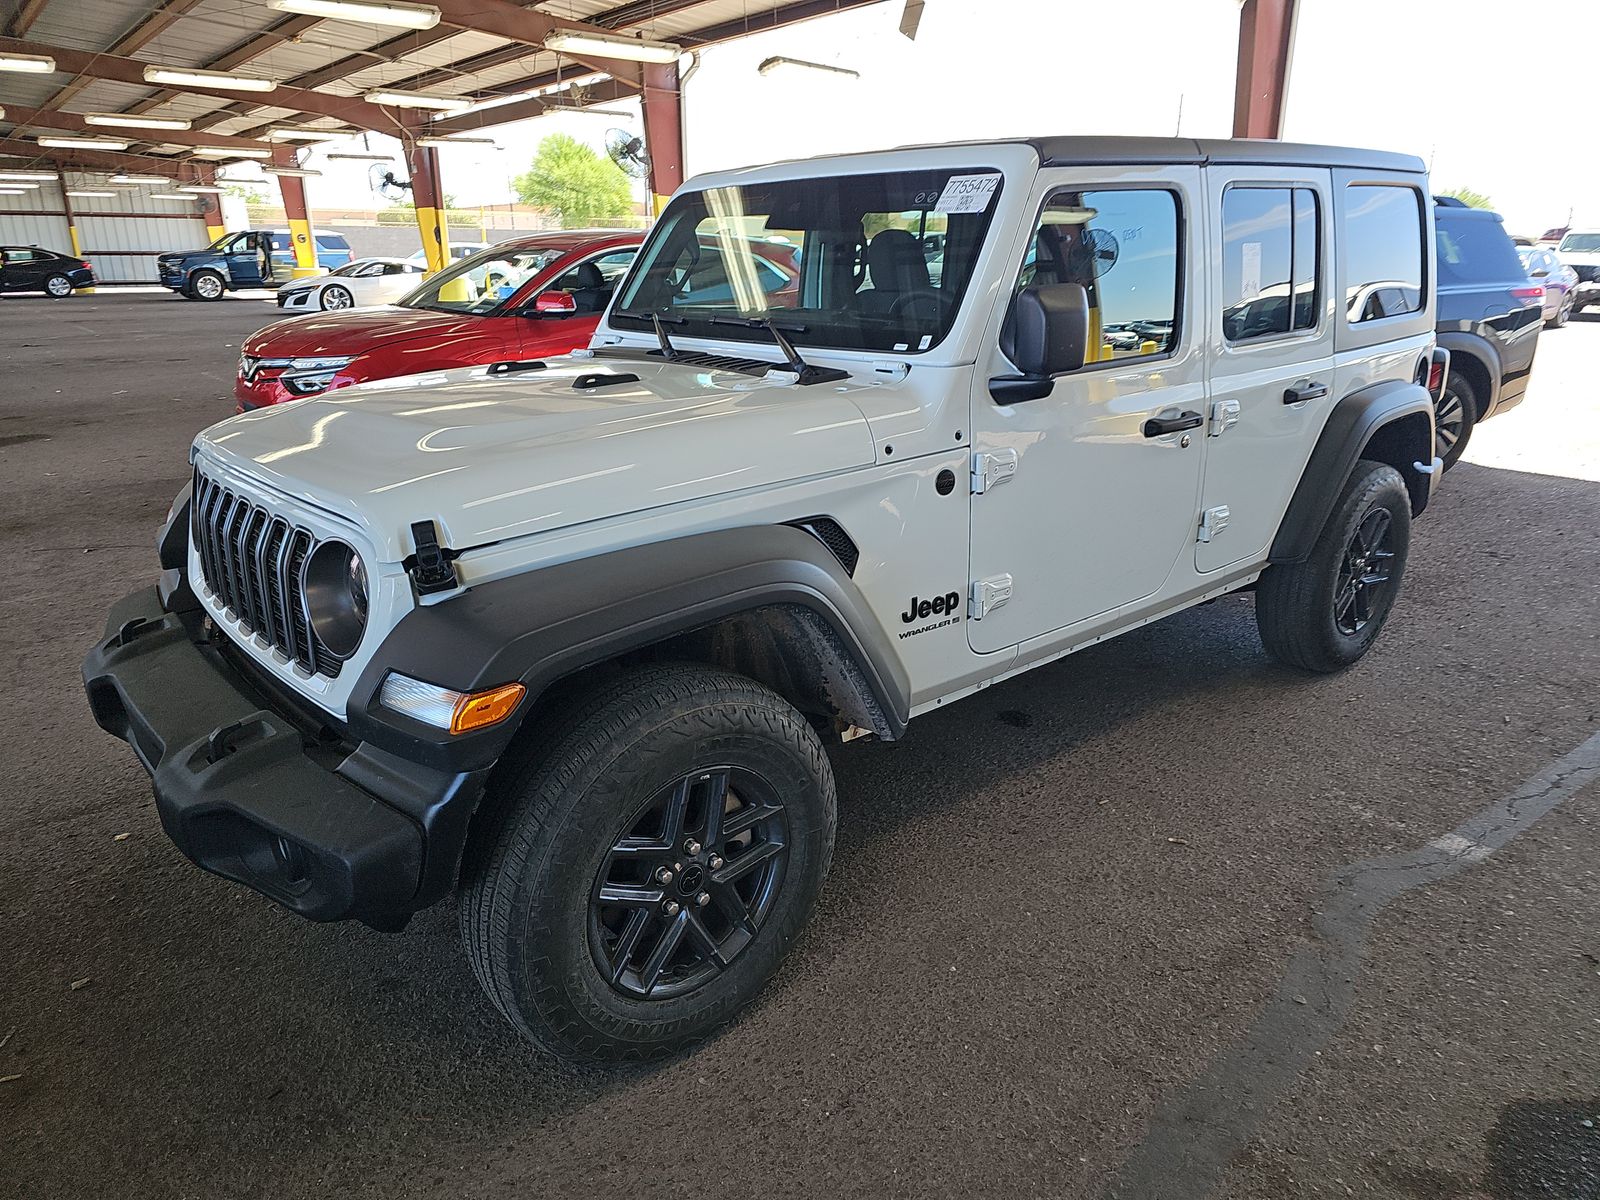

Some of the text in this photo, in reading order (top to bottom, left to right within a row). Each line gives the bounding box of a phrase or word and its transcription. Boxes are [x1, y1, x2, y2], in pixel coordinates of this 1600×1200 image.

[946, 178, 999, 194] 7755472
[901, 591, 960, 624] Jeep
[898, 619, 951, 640] WRANGLER
